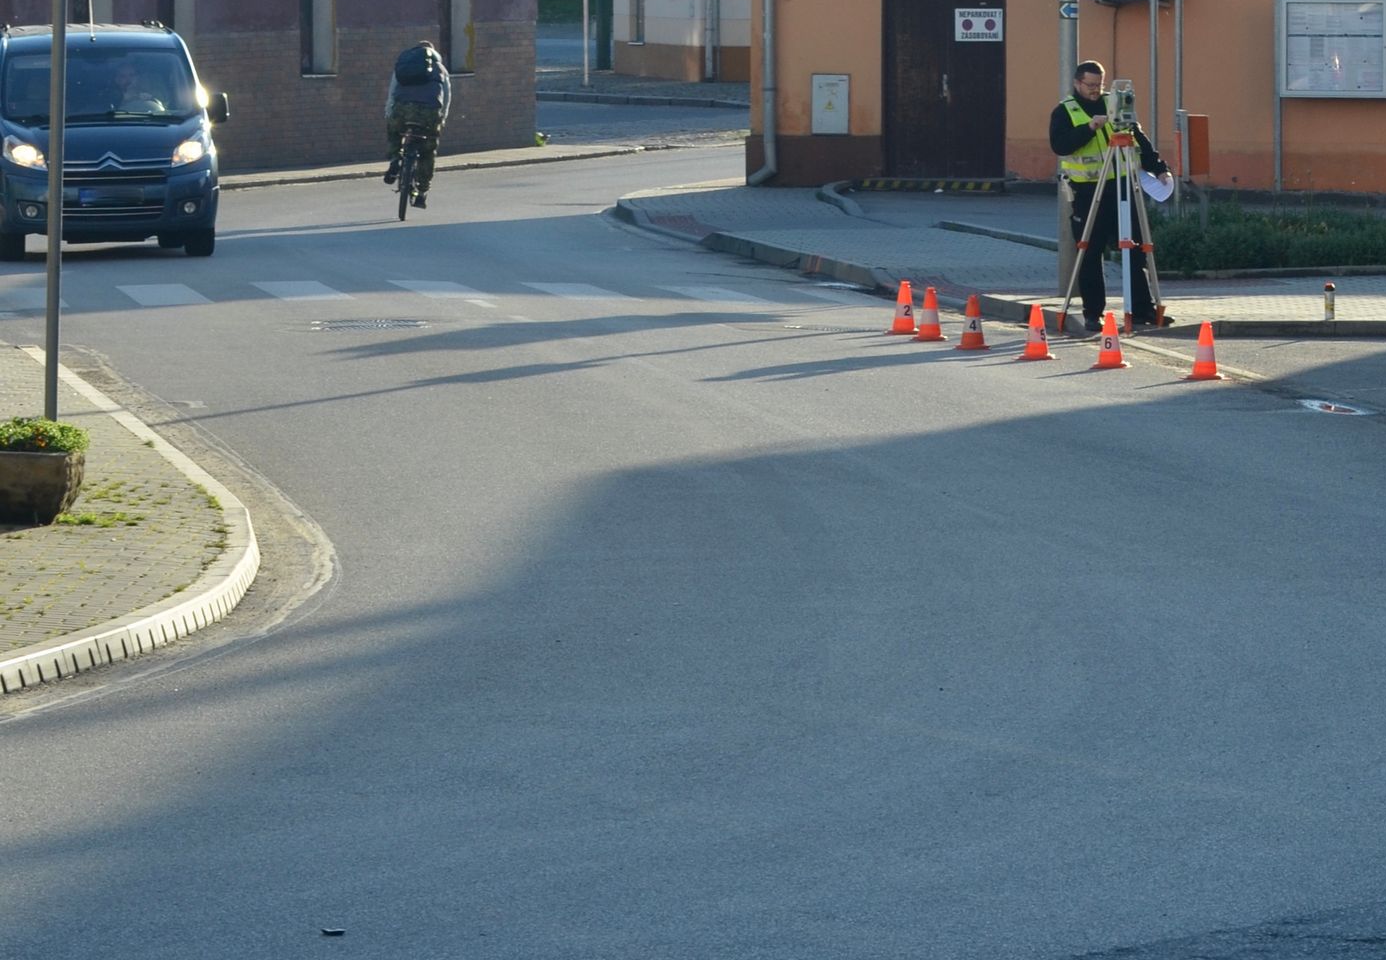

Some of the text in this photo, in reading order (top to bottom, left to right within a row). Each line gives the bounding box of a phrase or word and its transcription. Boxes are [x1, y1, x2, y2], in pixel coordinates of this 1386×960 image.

[903, 304, 911, 317] 2
[969, 319, 977, 331] 4
[1040, 328, 1046, 341] 5
[1104, 337, 1113, 350] 6
